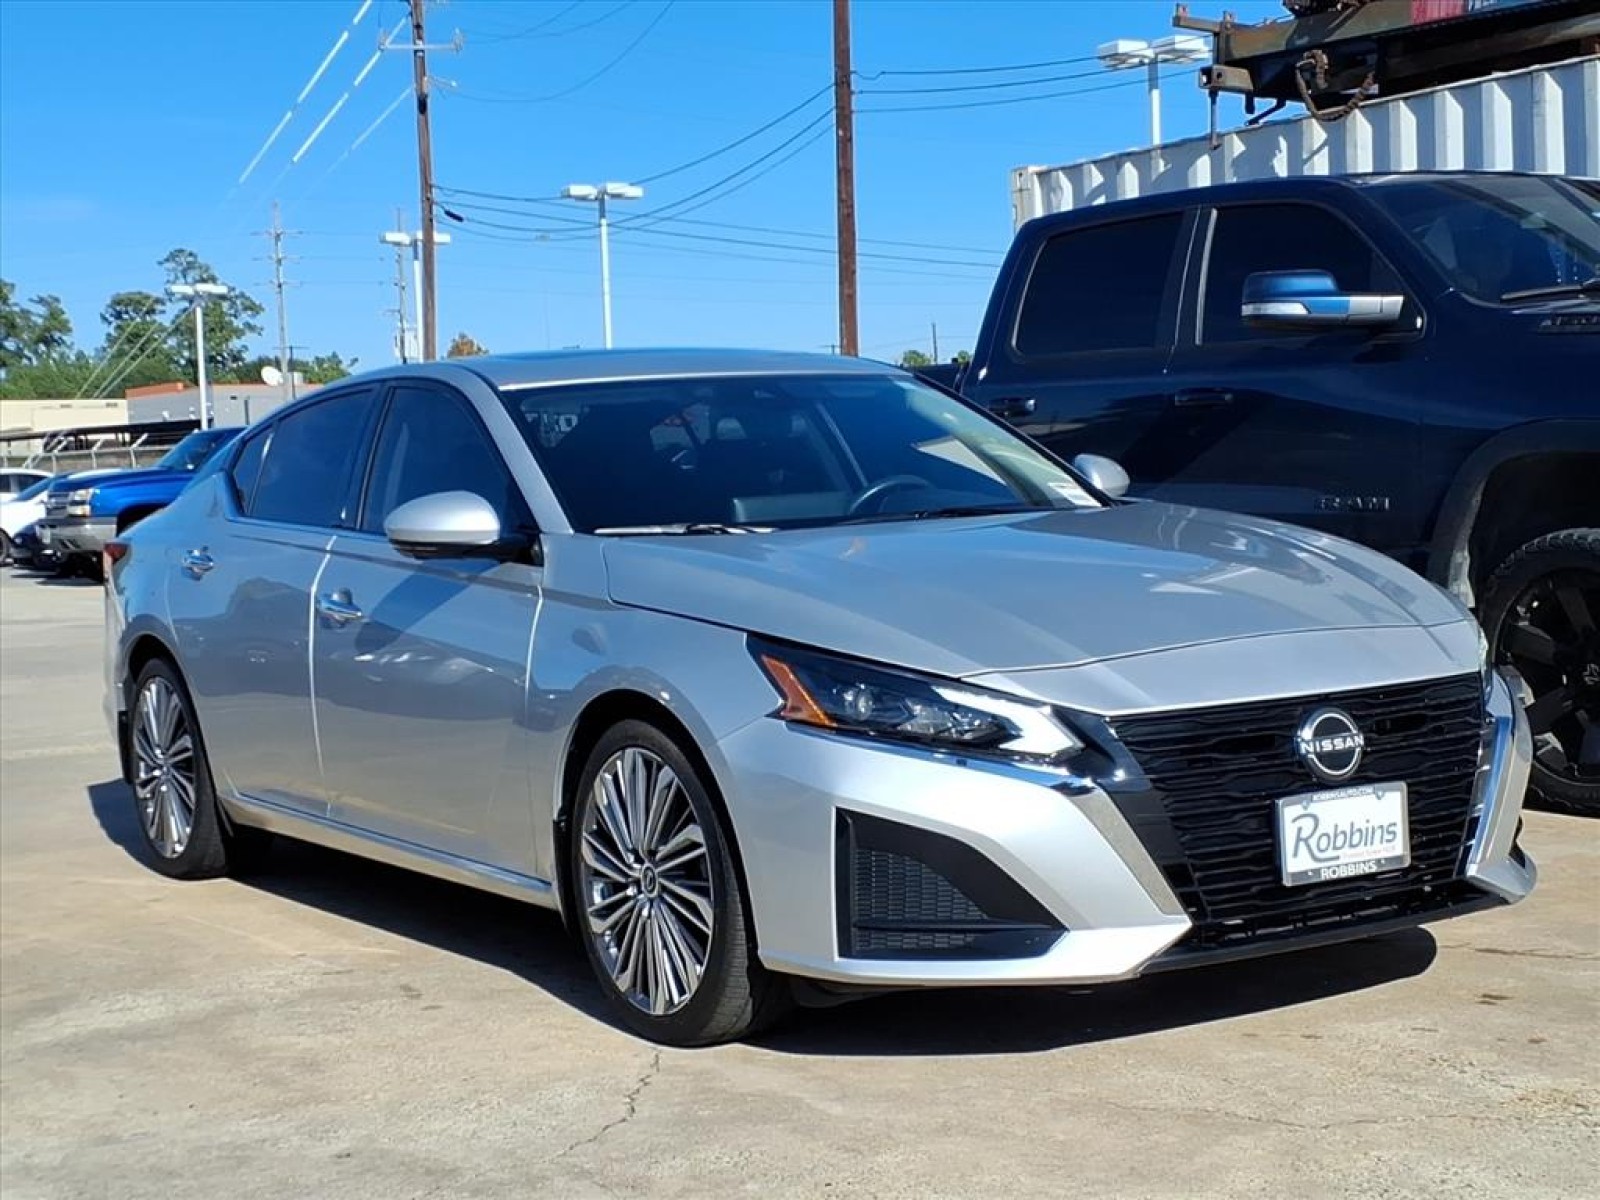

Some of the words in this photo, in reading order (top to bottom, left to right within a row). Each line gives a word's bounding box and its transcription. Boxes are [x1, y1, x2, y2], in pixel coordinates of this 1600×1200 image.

[1301, 734, 1364, 754] NISSAN
[1291, 813, 1398, 862] Robbins
[1320, 859, 1378, 880] ROBBINS
